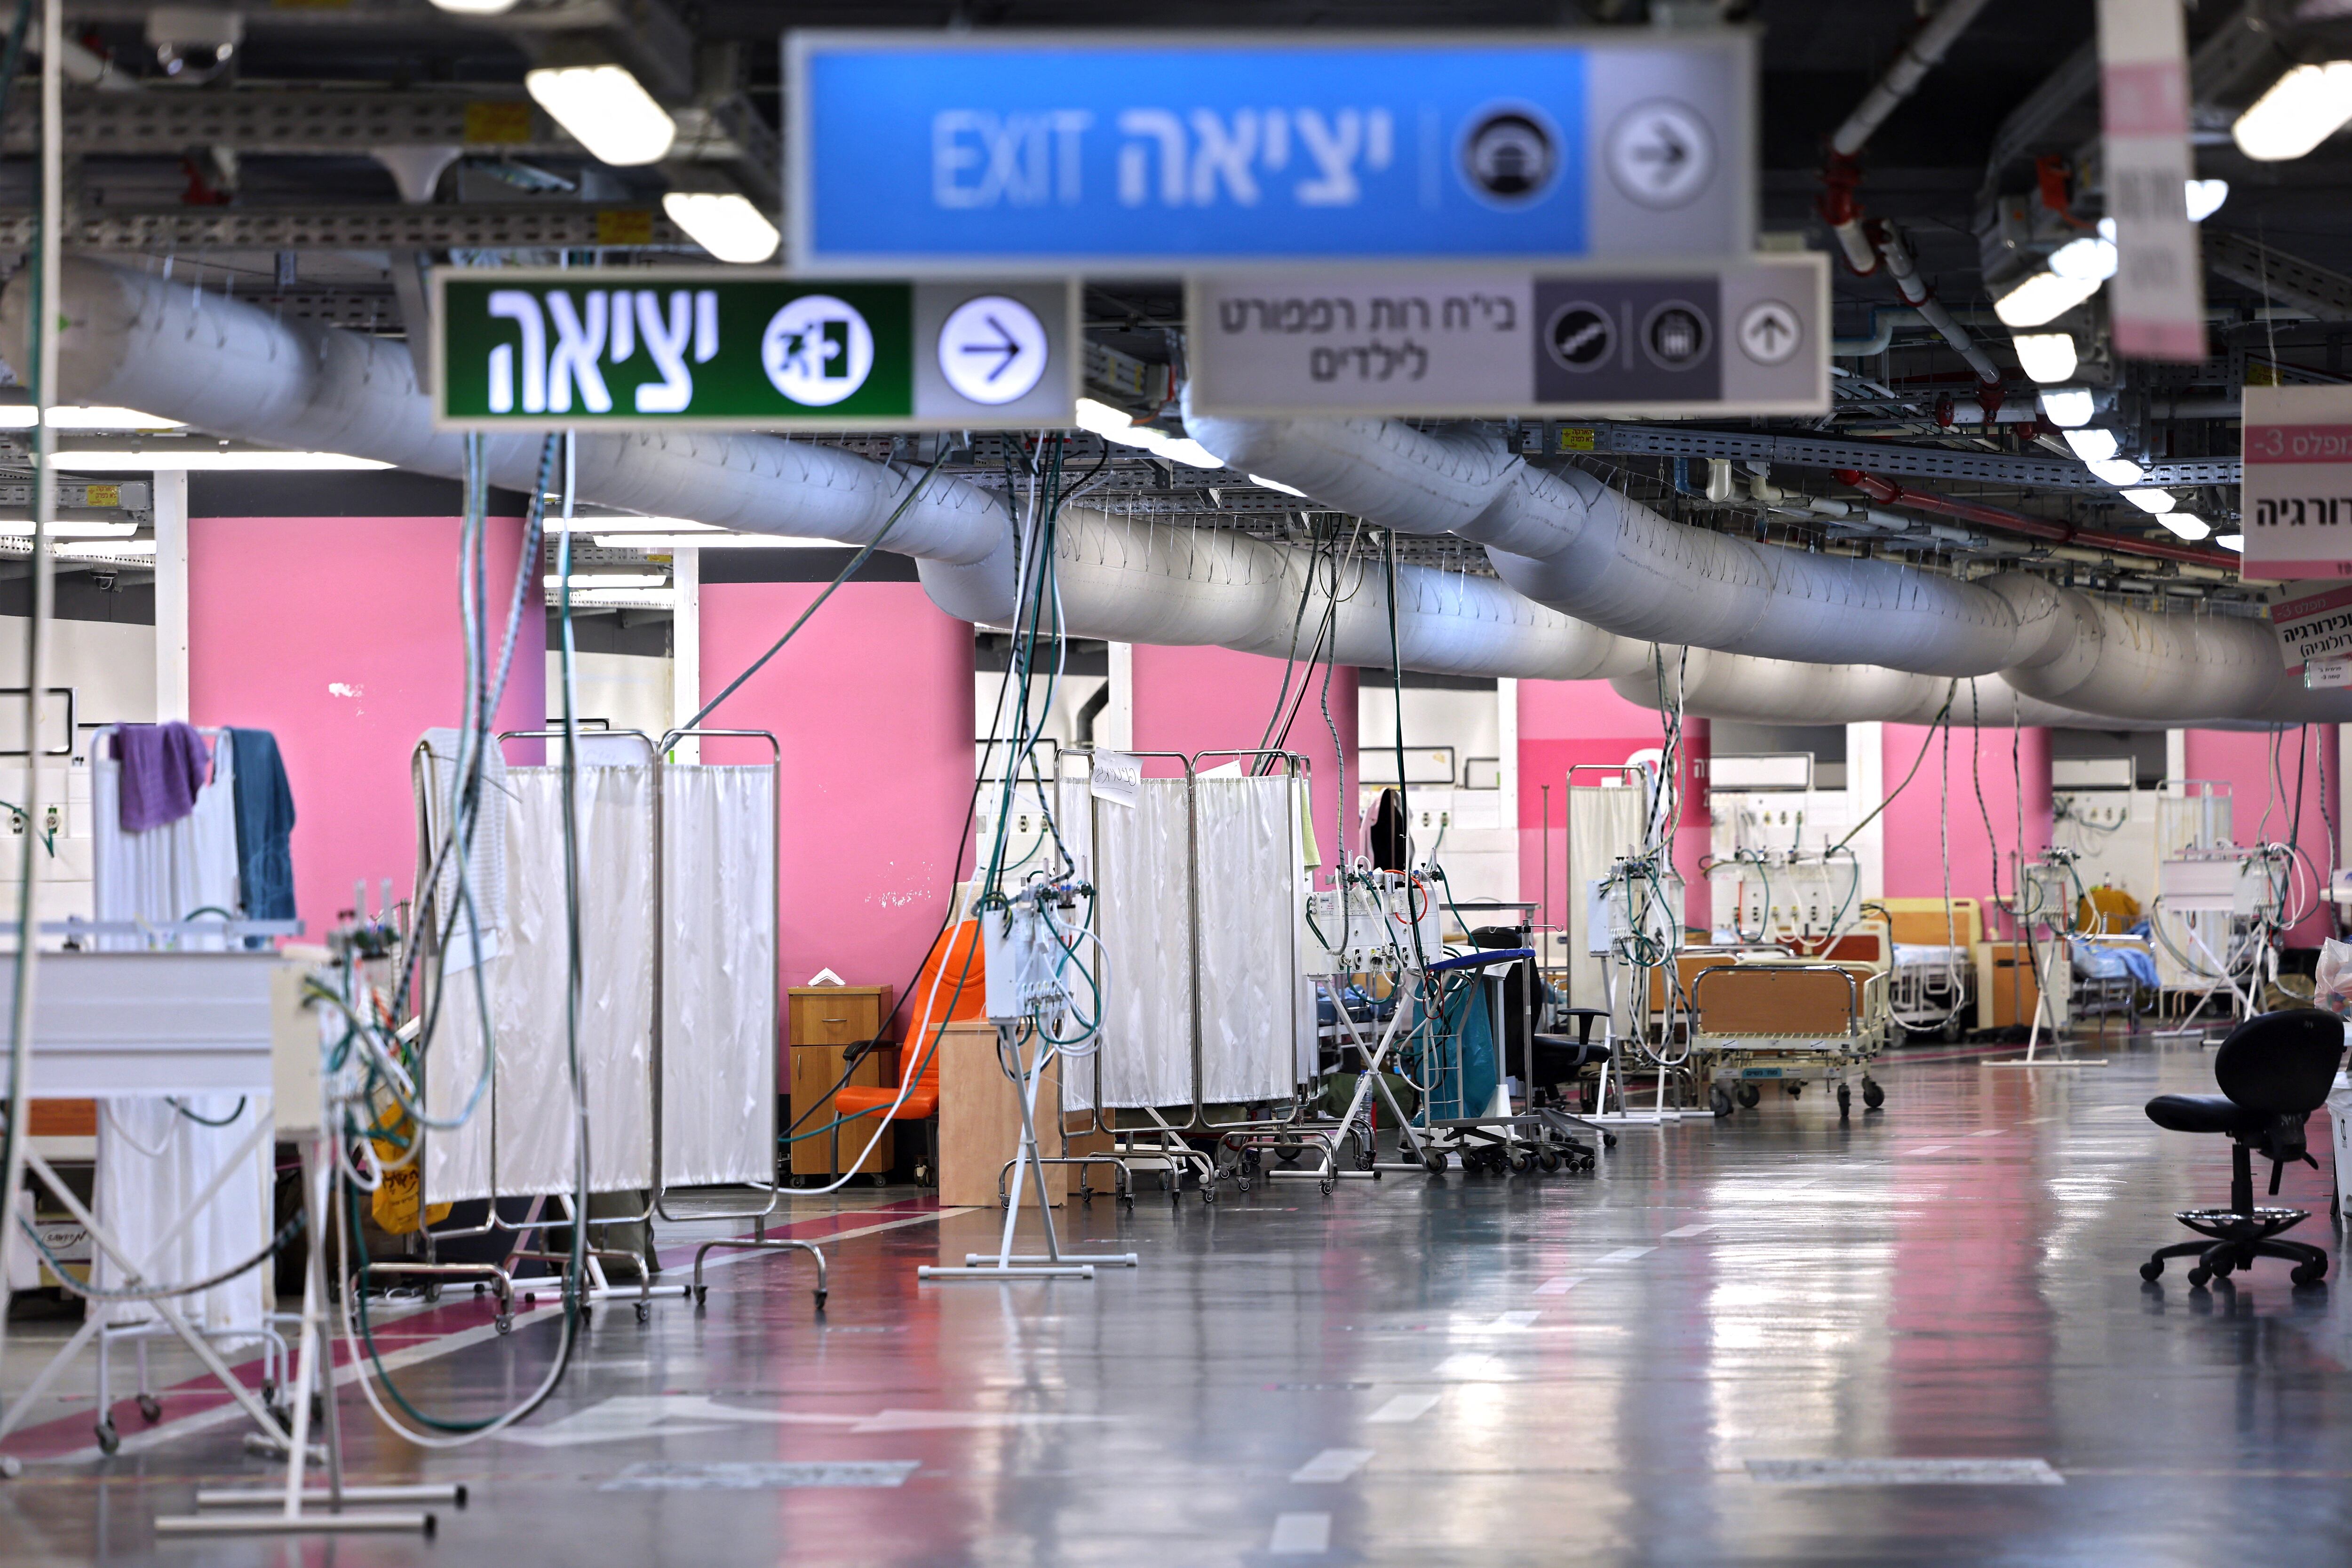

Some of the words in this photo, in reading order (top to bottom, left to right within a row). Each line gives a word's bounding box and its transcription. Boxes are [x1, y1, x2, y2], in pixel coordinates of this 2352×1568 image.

[931, 109, 1093, 211] EXIT
[1117, 106, 1393, 210] יציאה
[1219, 295, 1356, 334] רפפורט
[1369, 295, 1430, 332] רות
[487, 288, 719, 414] יציאה
[1310, 339, 1429, 382] לילדים
[2294, 598, 2327, 615] מפלס
